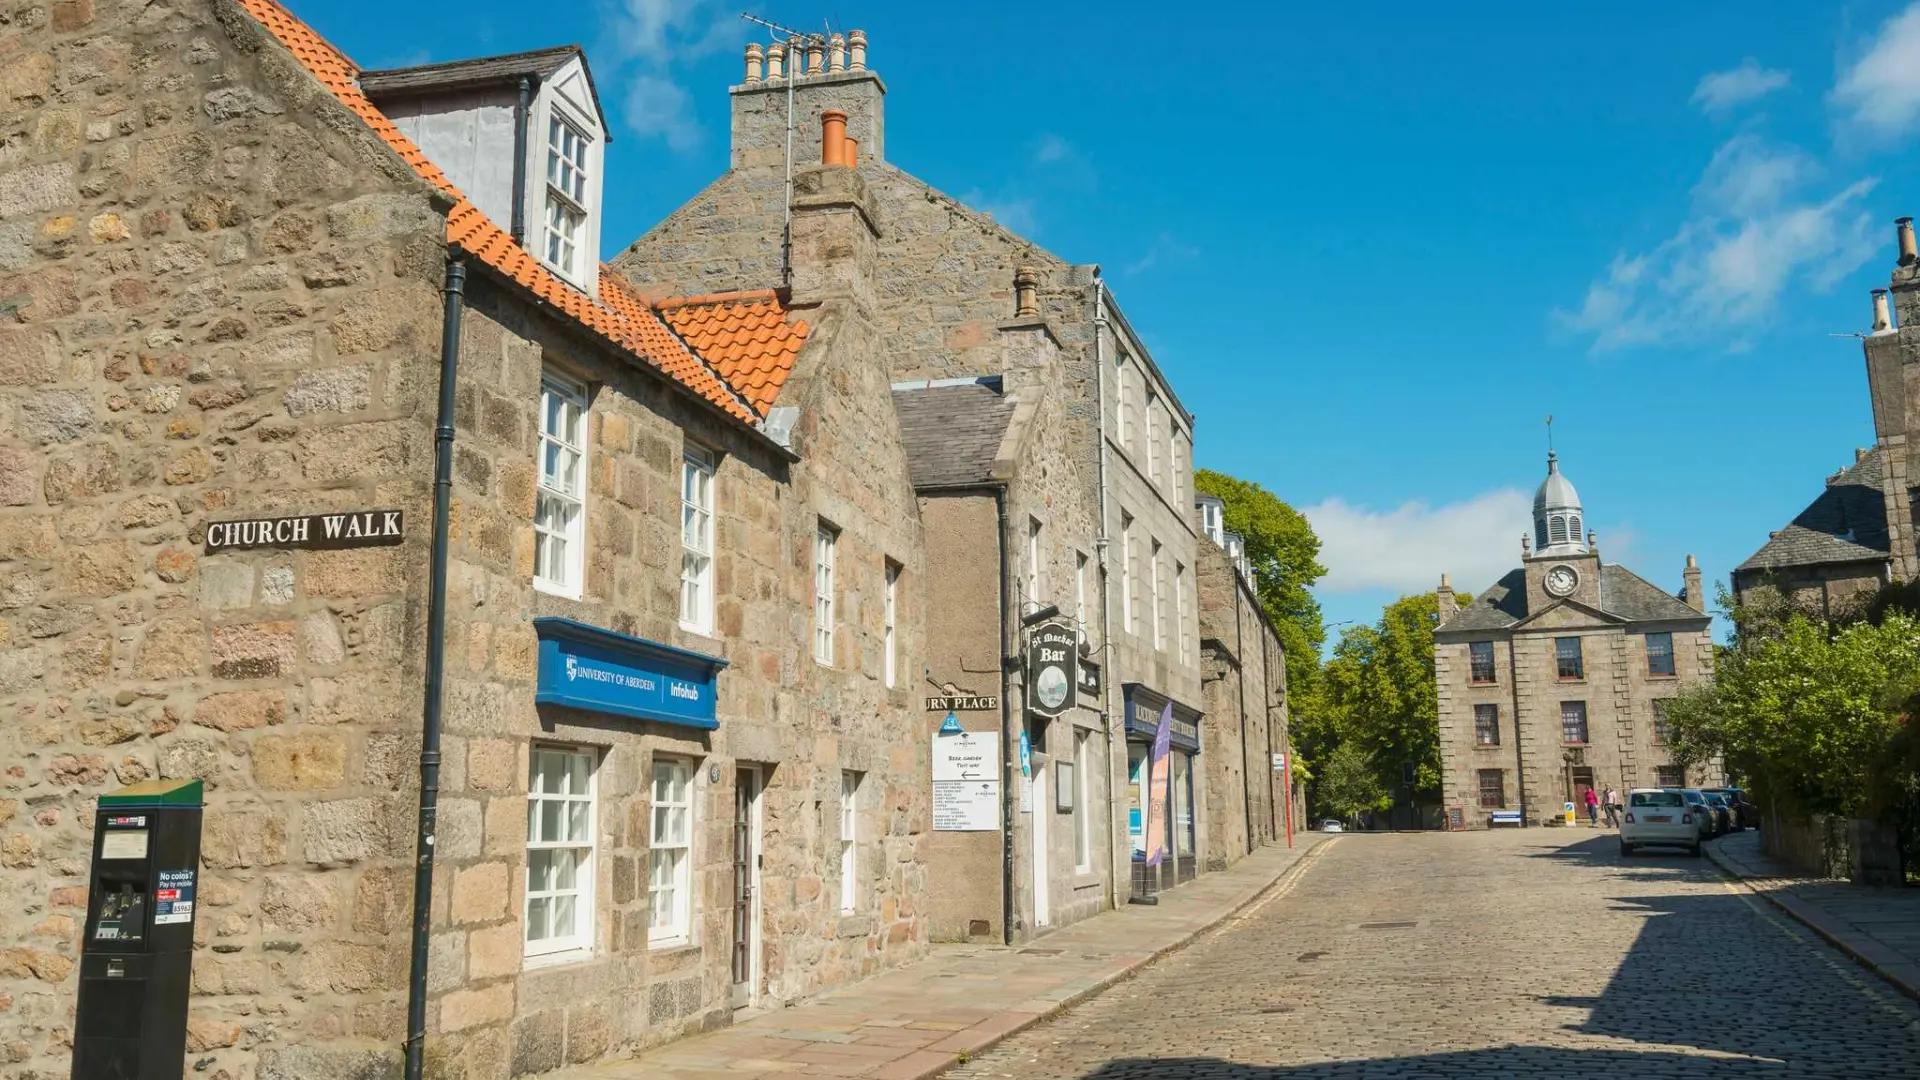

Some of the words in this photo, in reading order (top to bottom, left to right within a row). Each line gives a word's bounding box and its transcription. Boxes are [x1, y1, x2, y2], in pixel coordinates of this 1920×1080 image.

[207, 518, 310, 547] CHURCH
[322, 511, 401, 539] WALK
[1040, 648, 1066, 662] Bar
[577, 668, 614, 685] UNIVERSITY
[615, 673, 625, 686] OF
[625, 675, 655, 692] ABERDEEN
[670, 682, 699, 701] Infohub
[954, 697, 997, 709] PLACE
[160, 872, 170, 880] No
[171, 871, 194, 880] coins?
[160, 881, 169, 889] Pay
